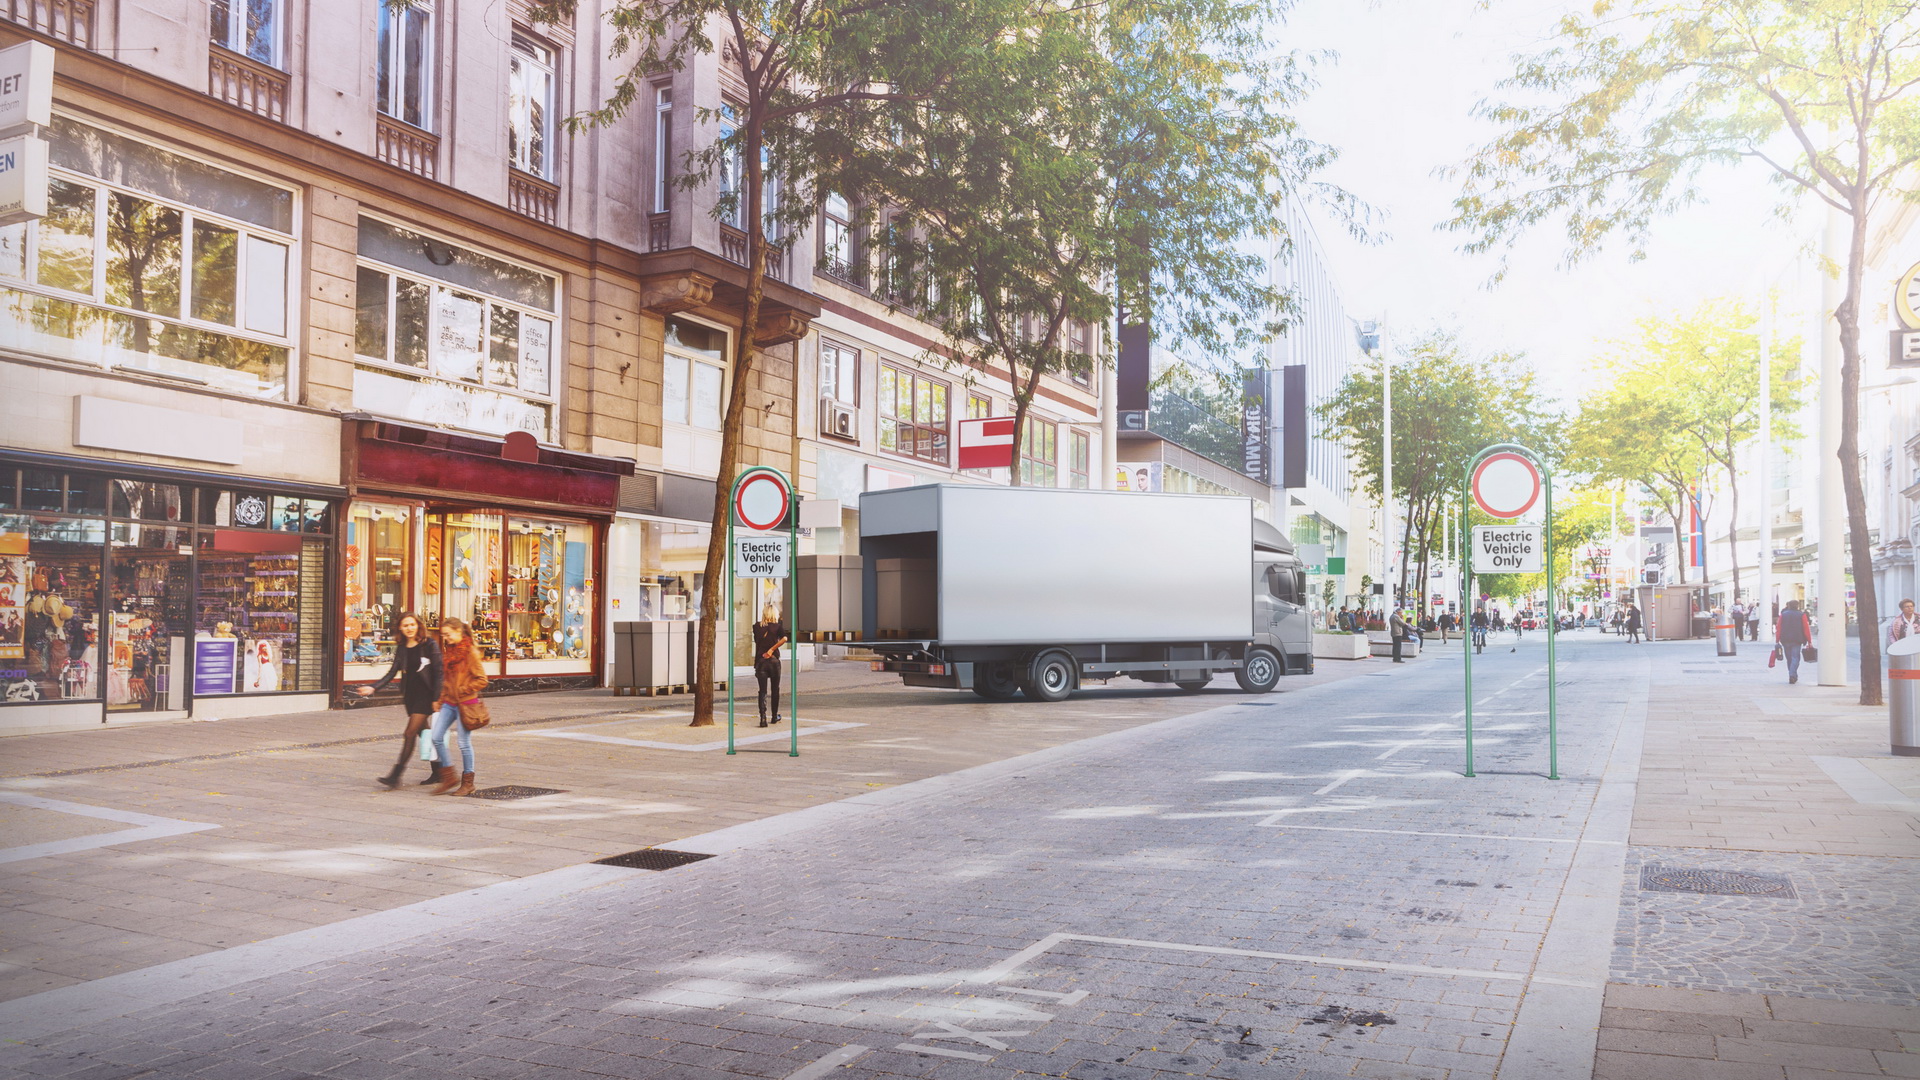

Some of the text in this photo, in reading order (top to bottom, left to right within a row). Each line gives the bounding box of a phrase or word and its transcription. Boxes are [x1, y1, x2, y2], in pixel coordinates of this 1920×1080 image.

[440, 332, 453, 341] 258
[1482, 530, 1532, 542] Electric
[741, 542, 782, 552] Electric
[1483, 542, 1531, 554] Vehicle
[742, 552, 781, 562] Vehicle
[1493, 555, 1522, 568] Only
[750, 563, 774, 574] Only
